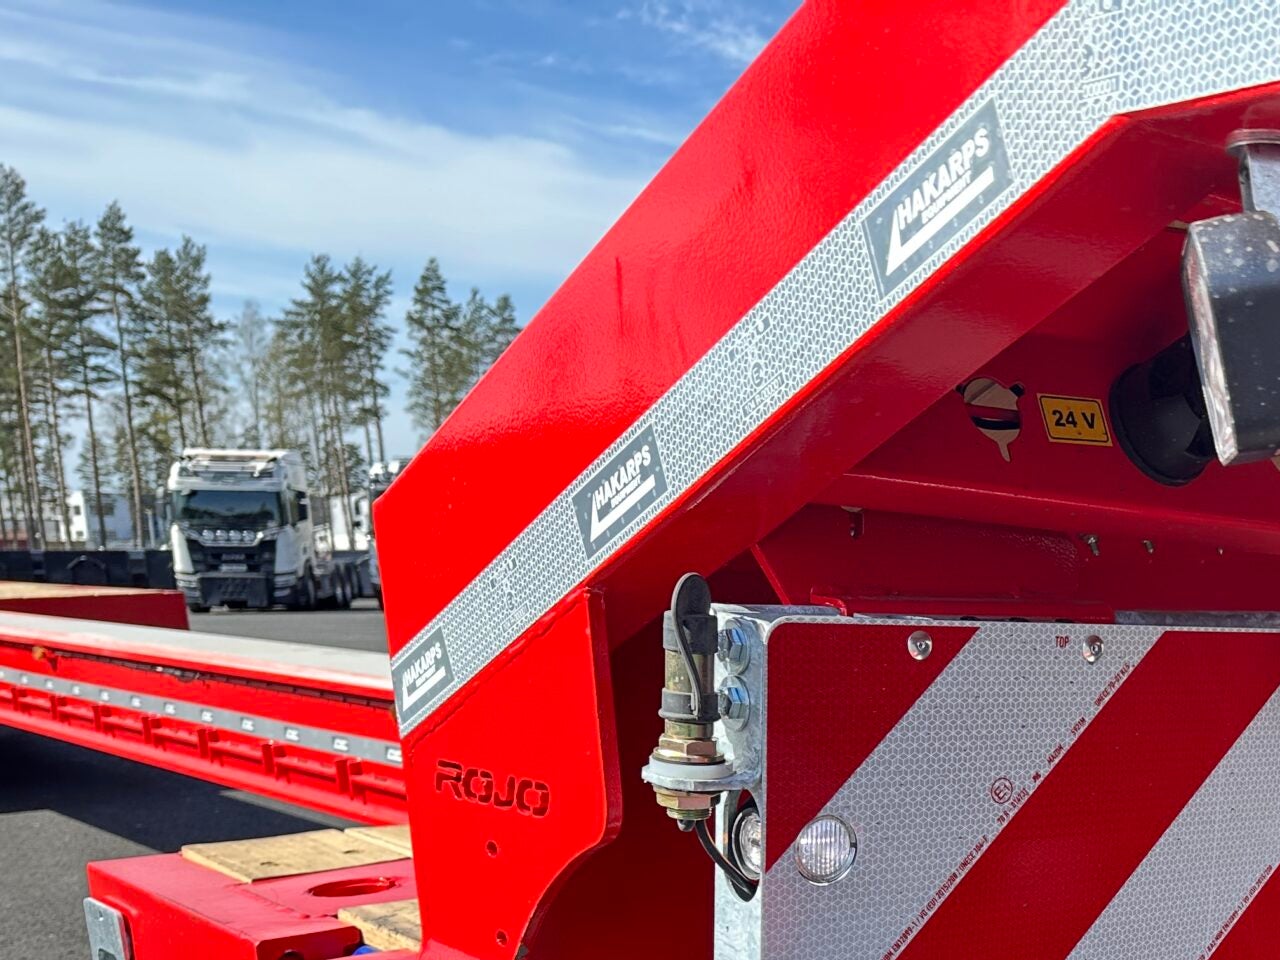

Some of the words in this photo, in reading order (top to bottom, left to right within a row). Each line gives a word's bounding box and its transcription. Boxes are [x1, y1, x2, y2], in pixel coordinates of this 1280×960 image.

[896, 127, 991, 231] HAKARPS
[1052, 410, 1077, 428] 24
[1081, 411, 1095, 429] V
[594, 444, 652, 511] HAKARPS
[404, 641, 442, 688] HAKARPS
[1055, 635, 1070, 648] TOP
[435, 758, 550, 819] ROJO
[924, 896, 938, 911] (EU)
